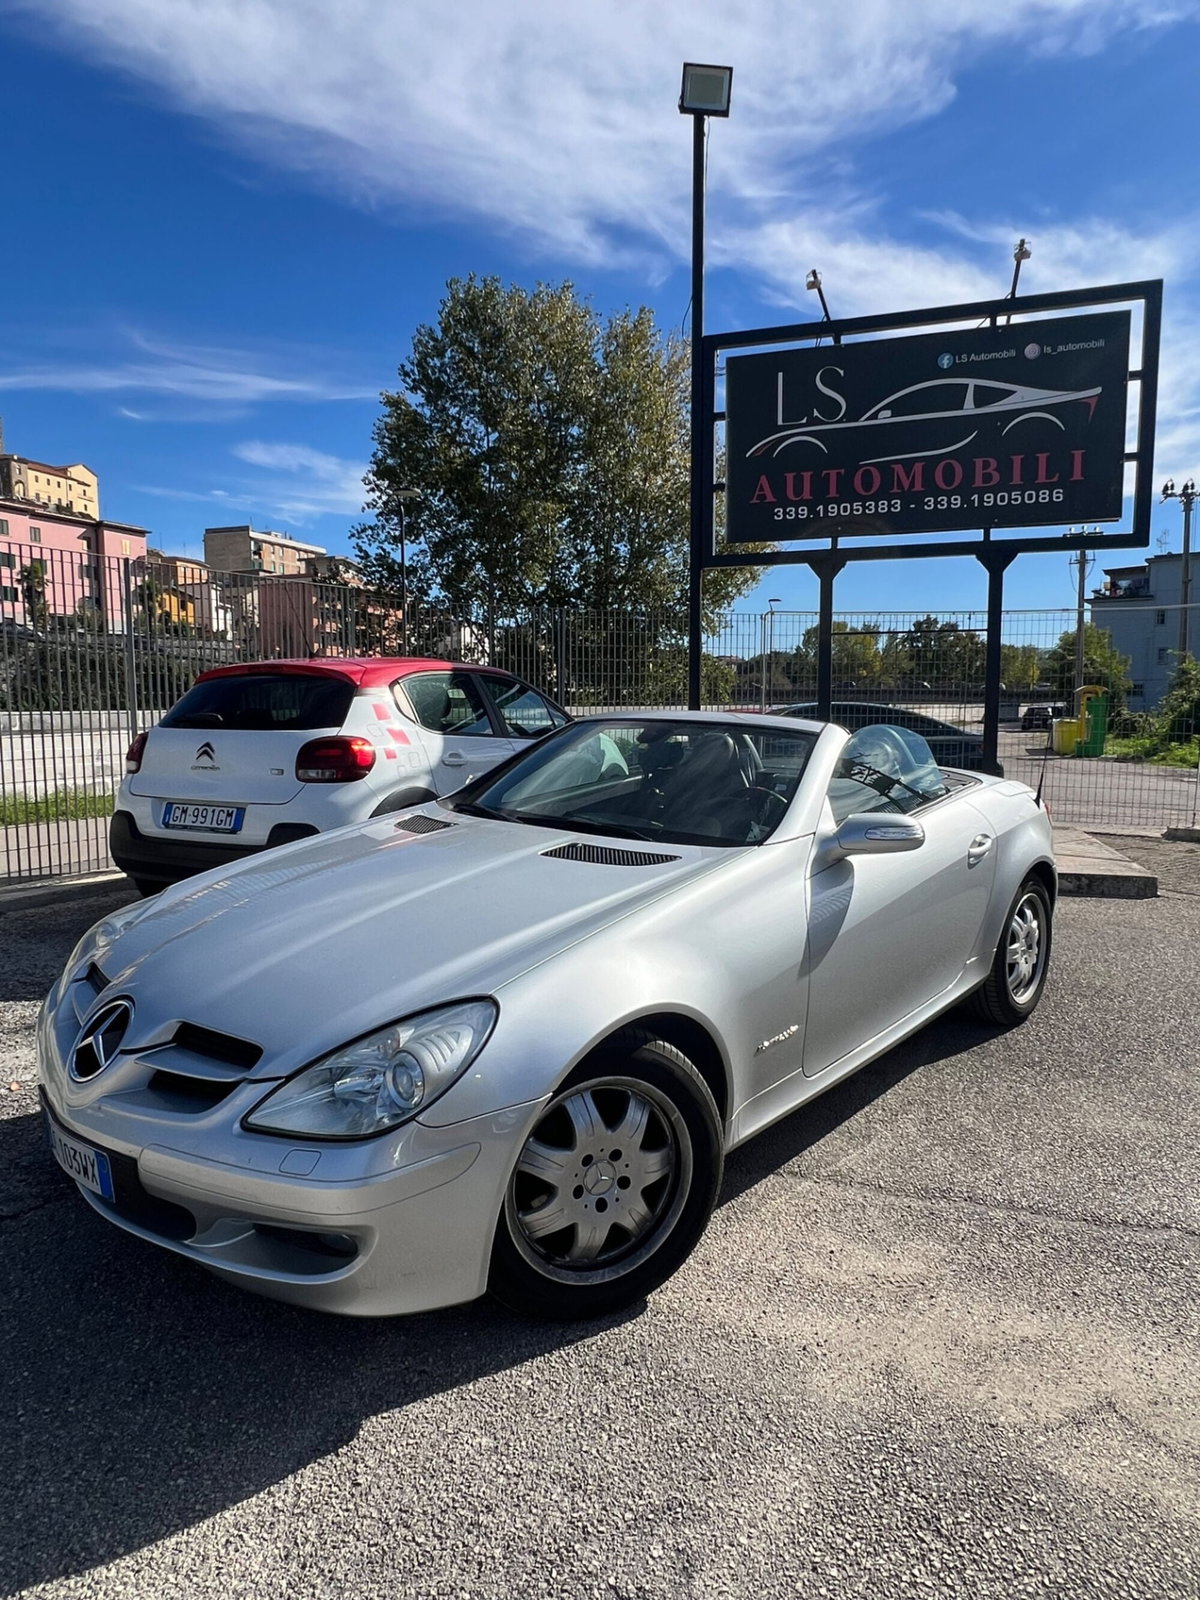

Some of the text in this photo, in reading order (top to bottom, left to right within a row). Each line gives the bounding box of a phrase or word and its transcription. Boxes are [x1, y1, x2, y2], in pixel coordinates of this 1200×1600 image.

[955, 349, 1017, 363] LS Automobili
[777, 365, 847, 426] LS
[749, 449, 1086, 504] AUTOMOBILI
[773, 499, 901, 520] 339.1905383
[924, 488, 1064, 510] 339.1905086
